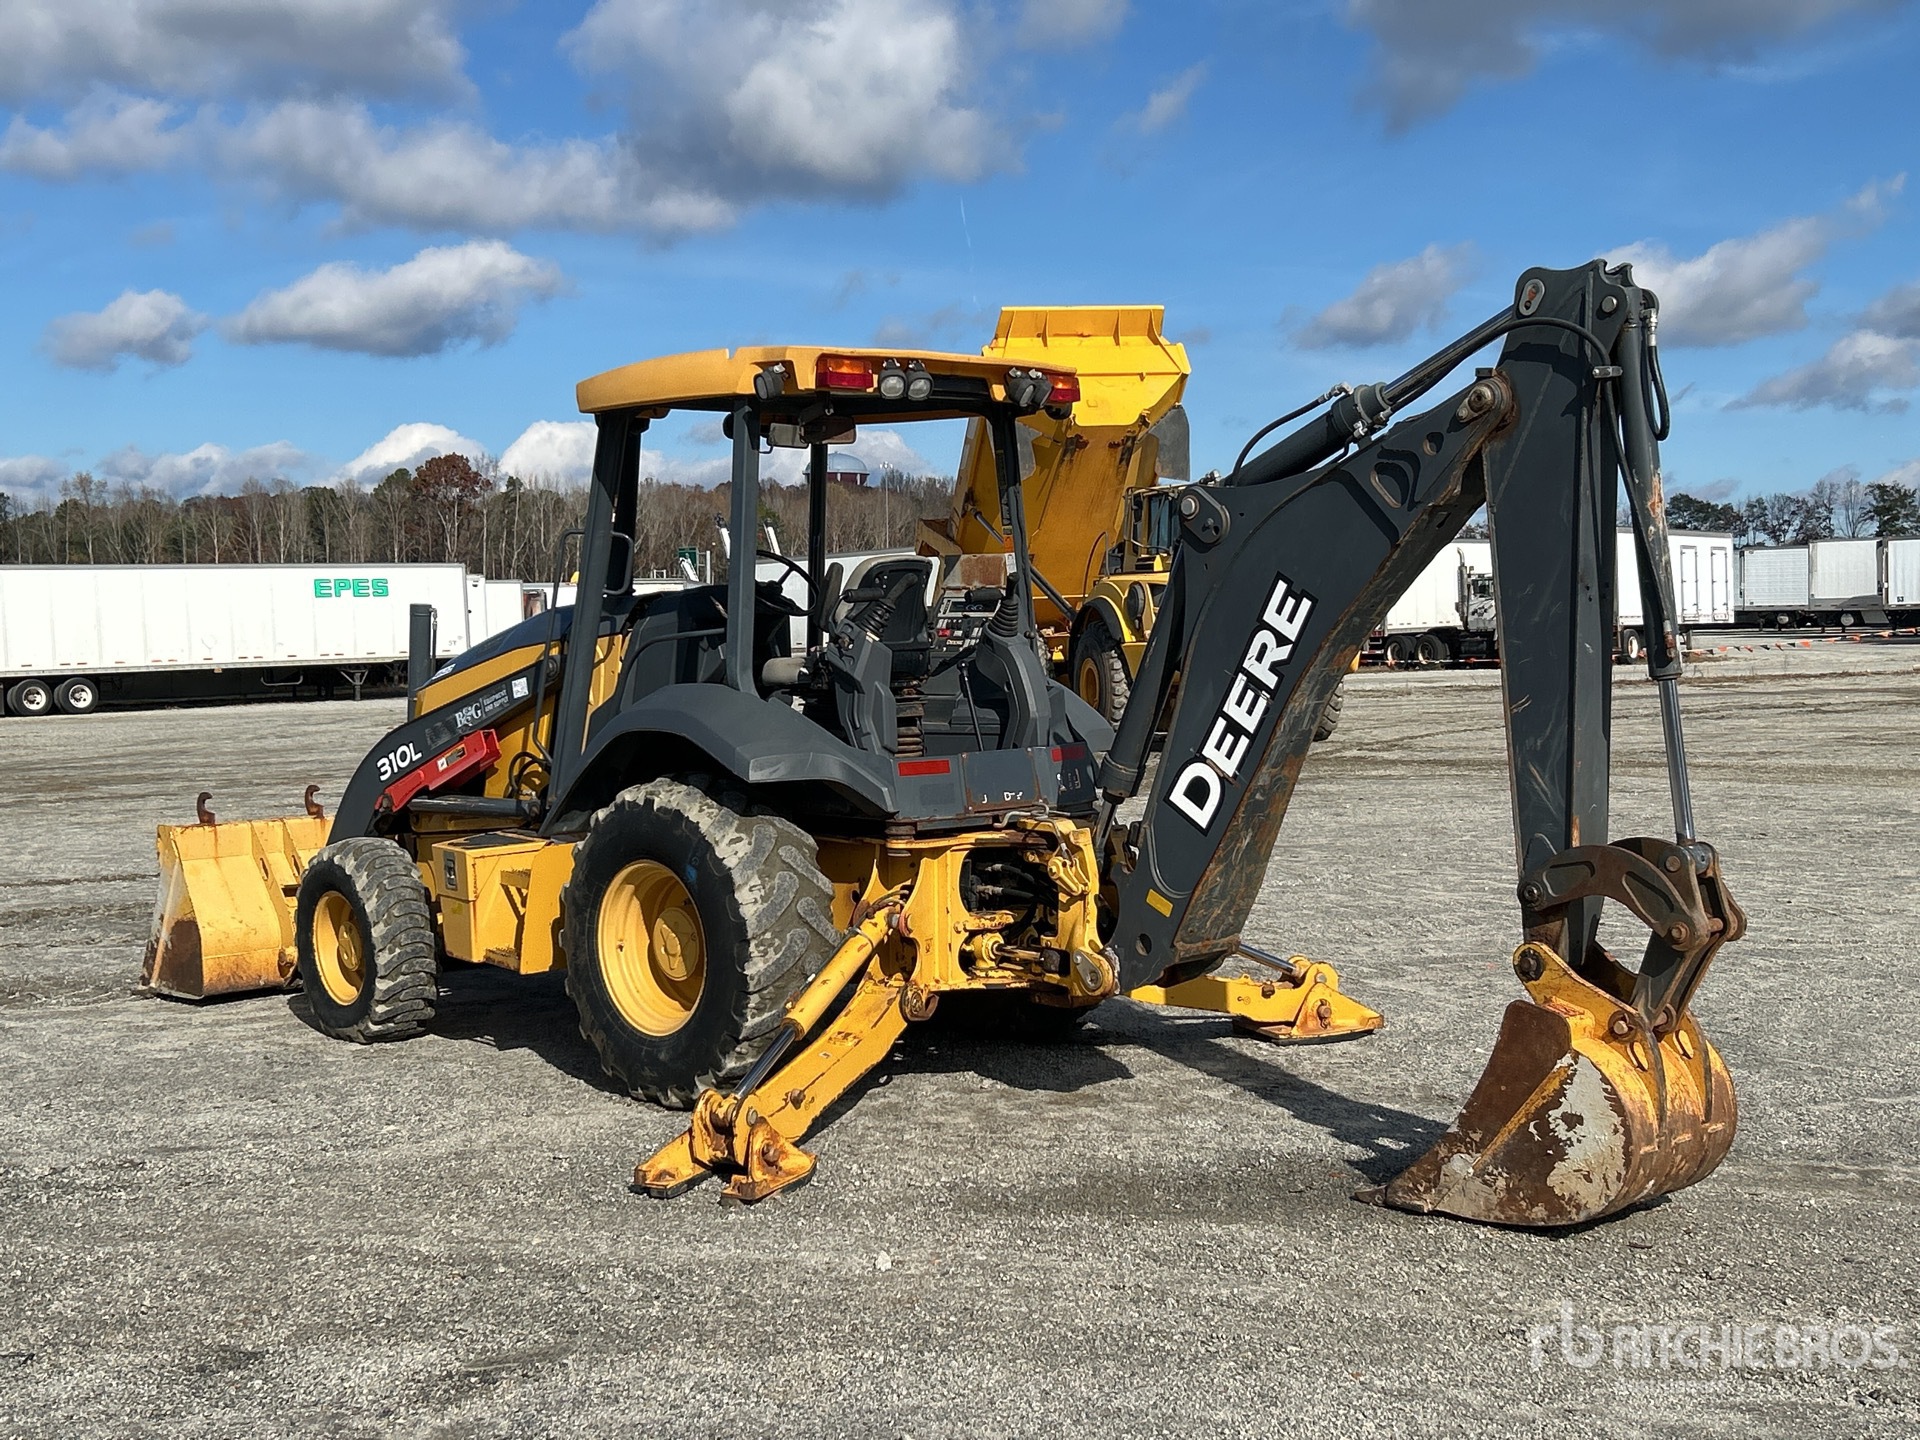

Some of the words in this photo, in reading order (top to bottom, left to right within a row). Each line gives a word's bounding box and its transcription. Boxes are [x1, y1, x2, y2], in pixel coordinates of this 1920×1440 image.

[314, 578, 389, 598] EPES
[1167, 578, 1313, 830] DEERE
[376, 742, 423, 781] 310L
